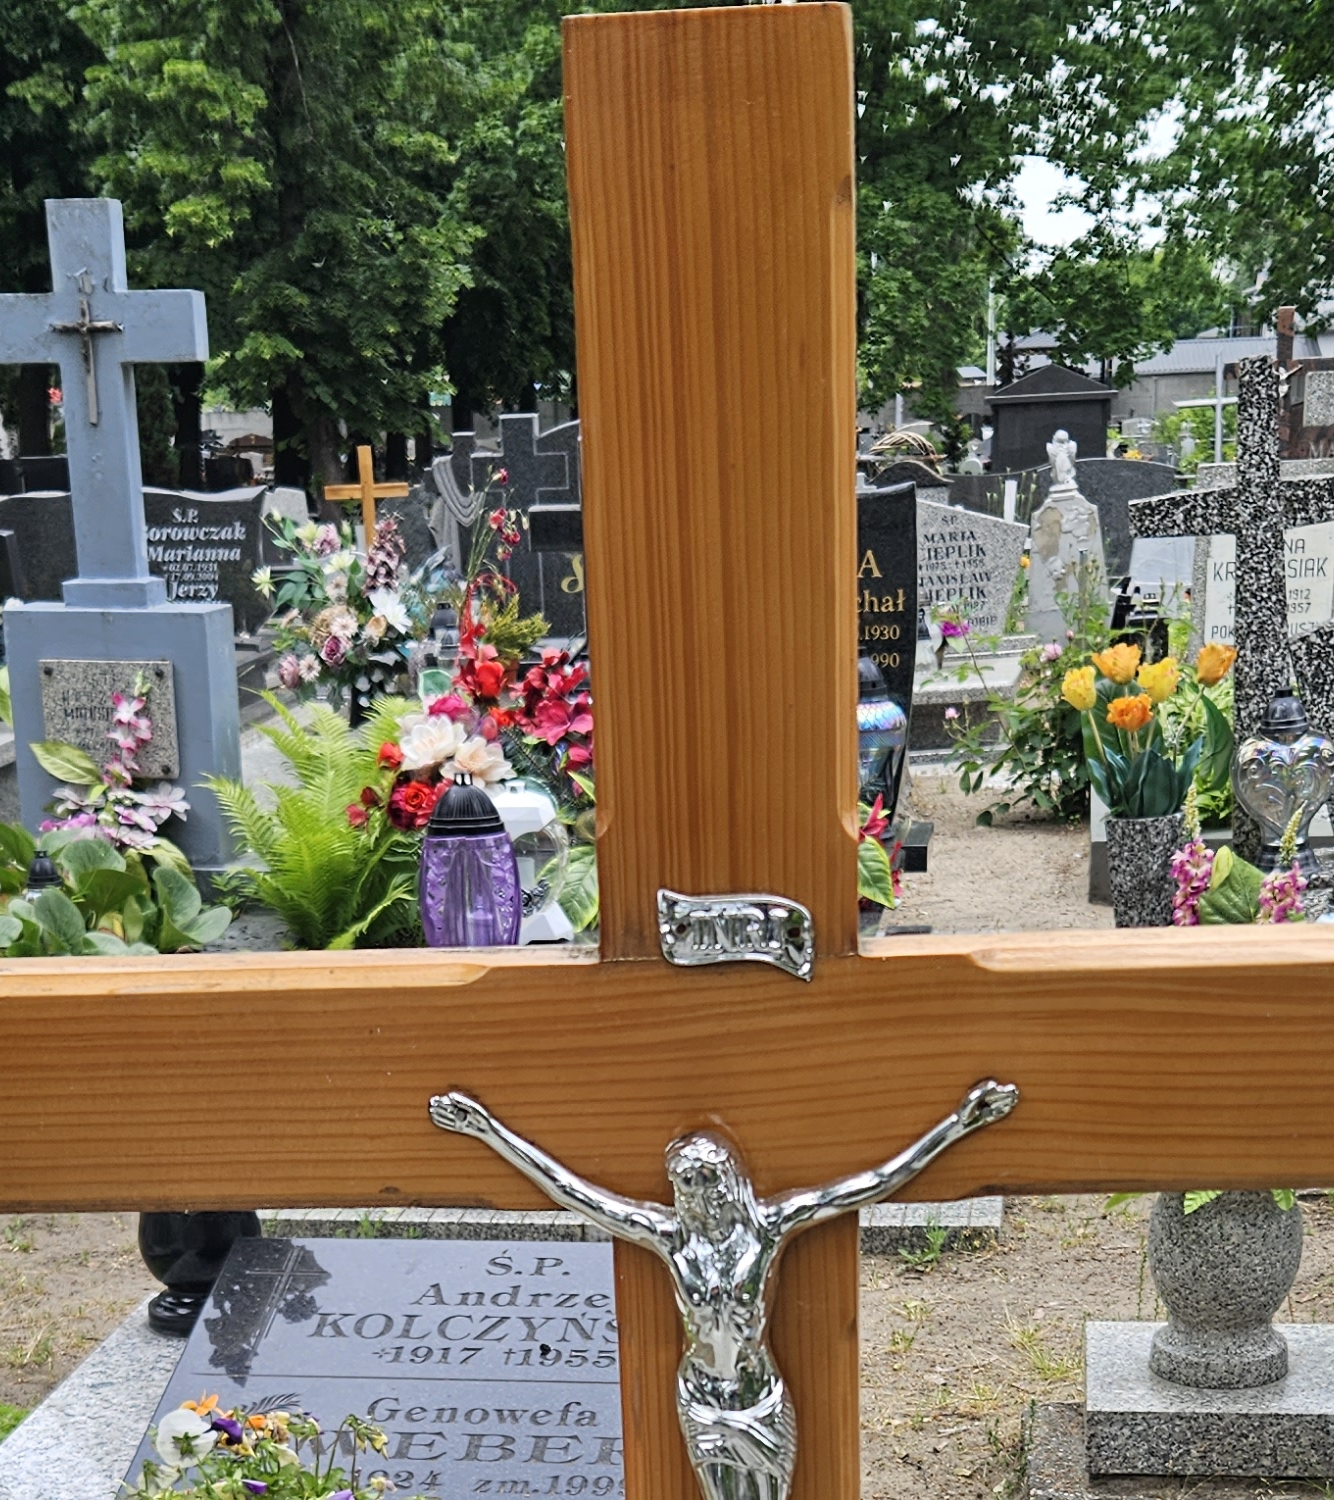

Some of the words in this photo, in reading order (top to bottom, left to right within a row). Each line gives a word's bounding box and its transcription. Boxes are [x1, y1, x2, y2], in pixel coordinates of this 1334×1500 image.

[144, 521, 247, 542] orowczak
[922, 530, 978, 545] MARIA
[147, 545, 242, 563] Marianna
[929, 586, 987, 603] IEPLIK
[409, 1282, 614, 1310] Andrze
[306, 1309, 619, 1345] KOLCZYŃS
[367, 1397, 599, 1428] Genowefa
